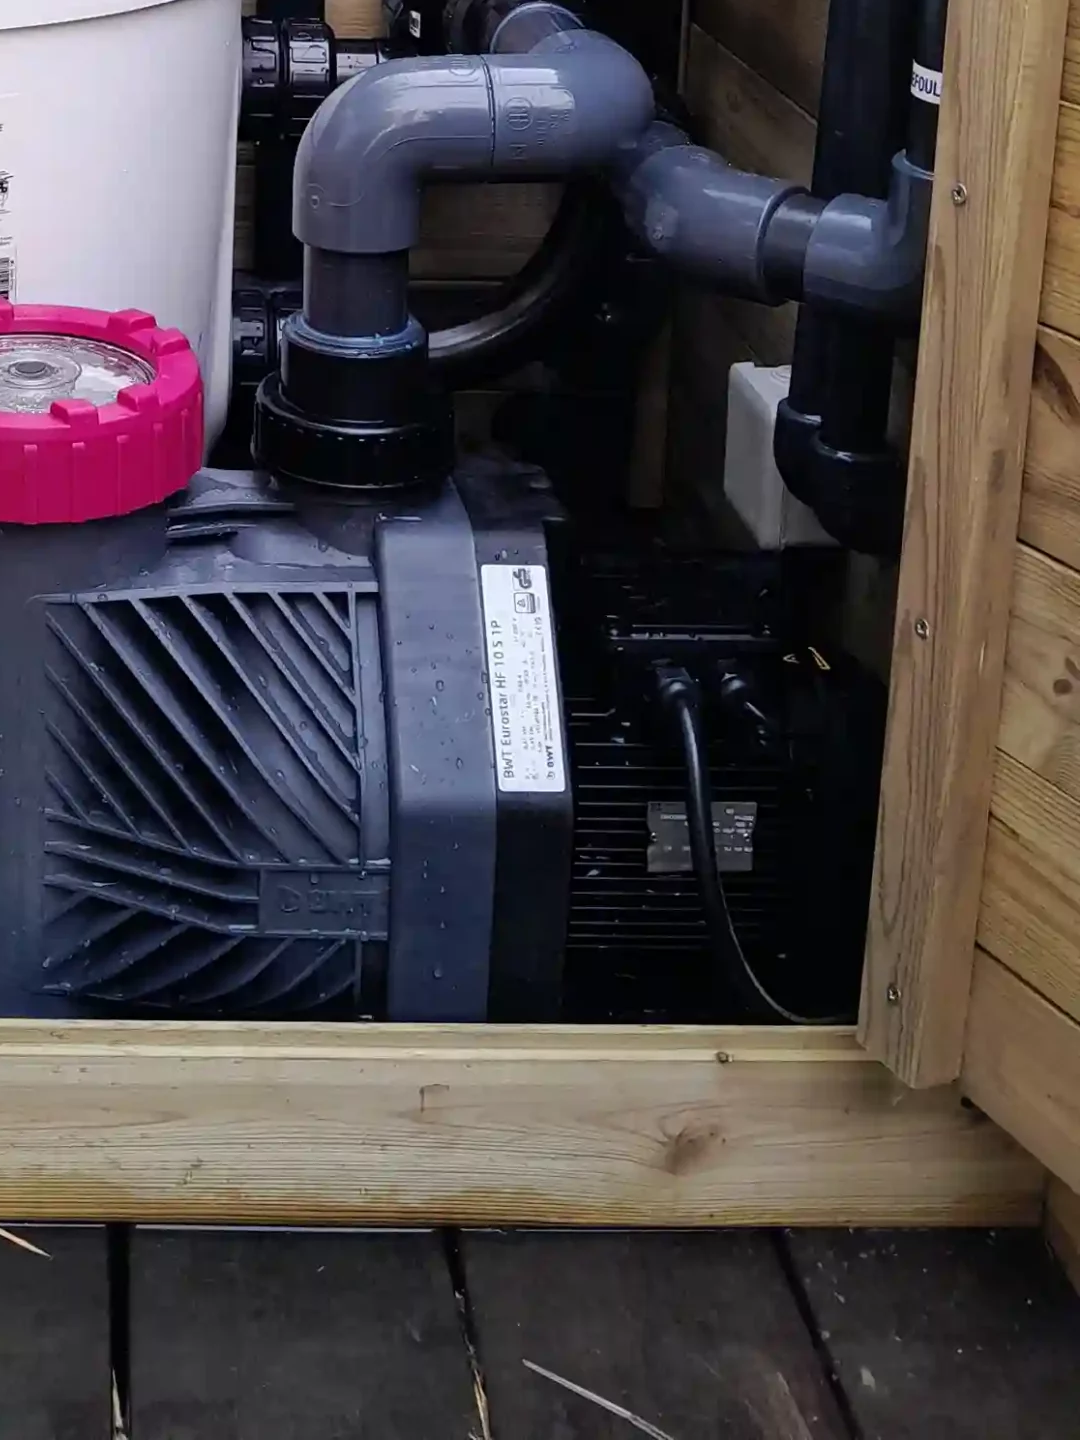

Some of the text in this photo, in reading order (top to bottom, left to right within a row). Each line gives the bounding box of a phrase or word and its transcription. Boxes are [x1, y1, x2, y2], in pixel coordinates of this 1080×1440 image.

[490, 620, 501, 635] 1P
[493, 651, 505, 666] 10
[495, 671, 507, 689] HF
[498, 693, 512, 746] Eurostar
[501, 751, 515, 779] BWT
[545, 745, 555, 768] BWT
